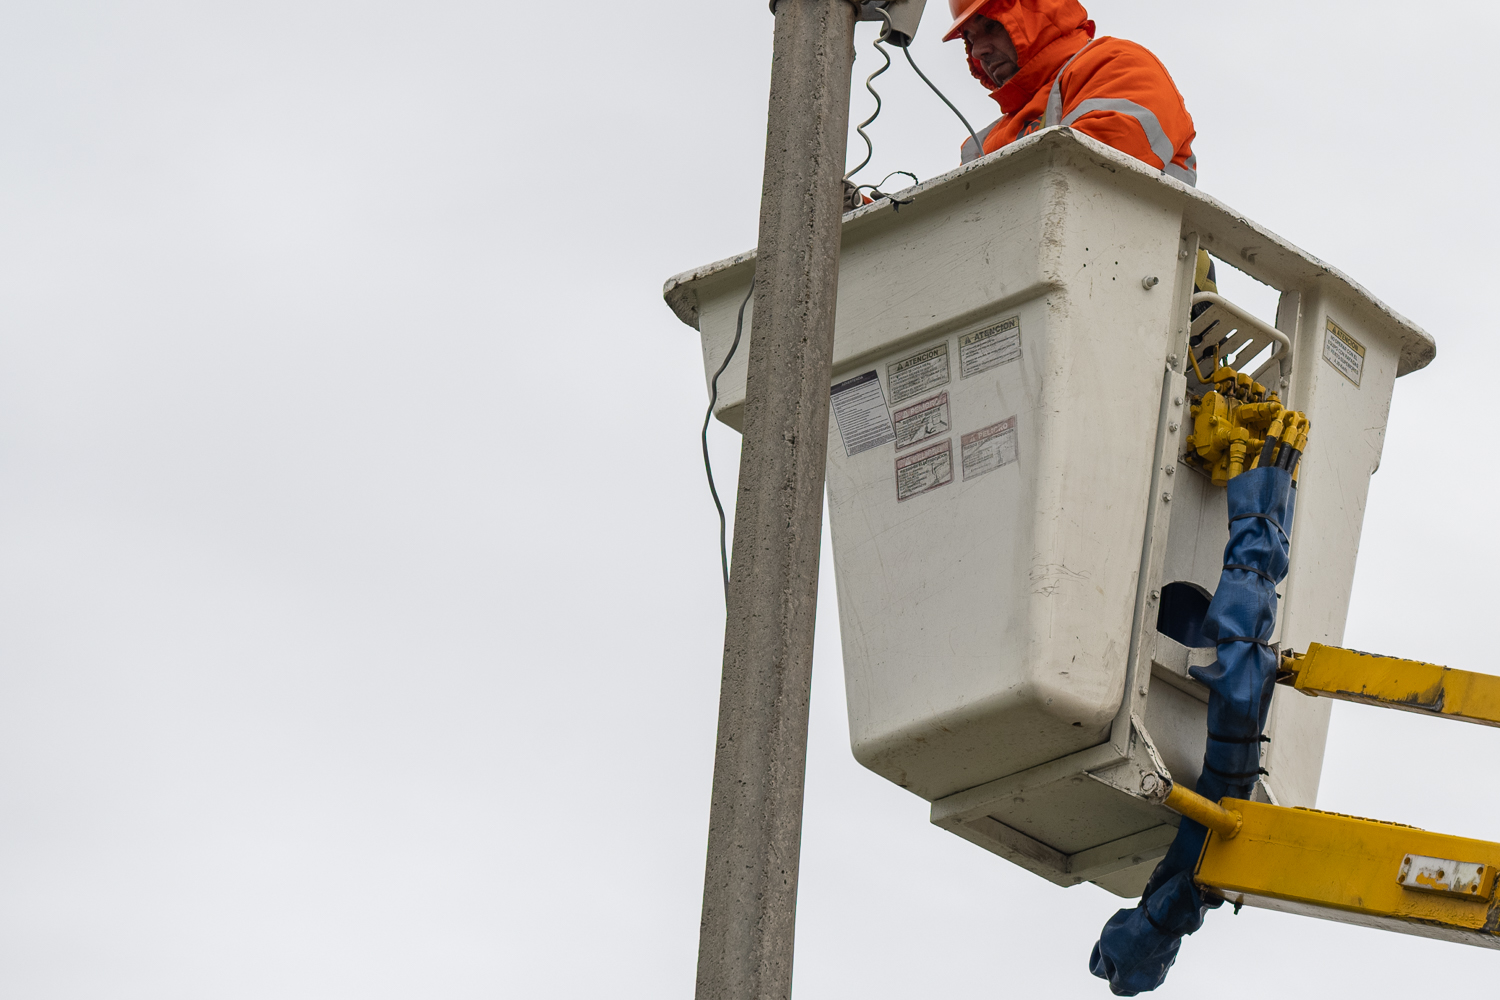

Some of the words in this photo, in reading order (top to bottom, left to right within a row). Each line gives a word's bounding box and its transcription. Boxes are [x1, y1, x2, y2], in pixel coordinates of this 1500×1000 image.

[974, 319, 1015, 341] ATENCION
[1335, 338, 1347, 350] OPERAR
[1337, 331, 1359, 351] ATENCION
[904, 349, 939, 368] ATENCION
